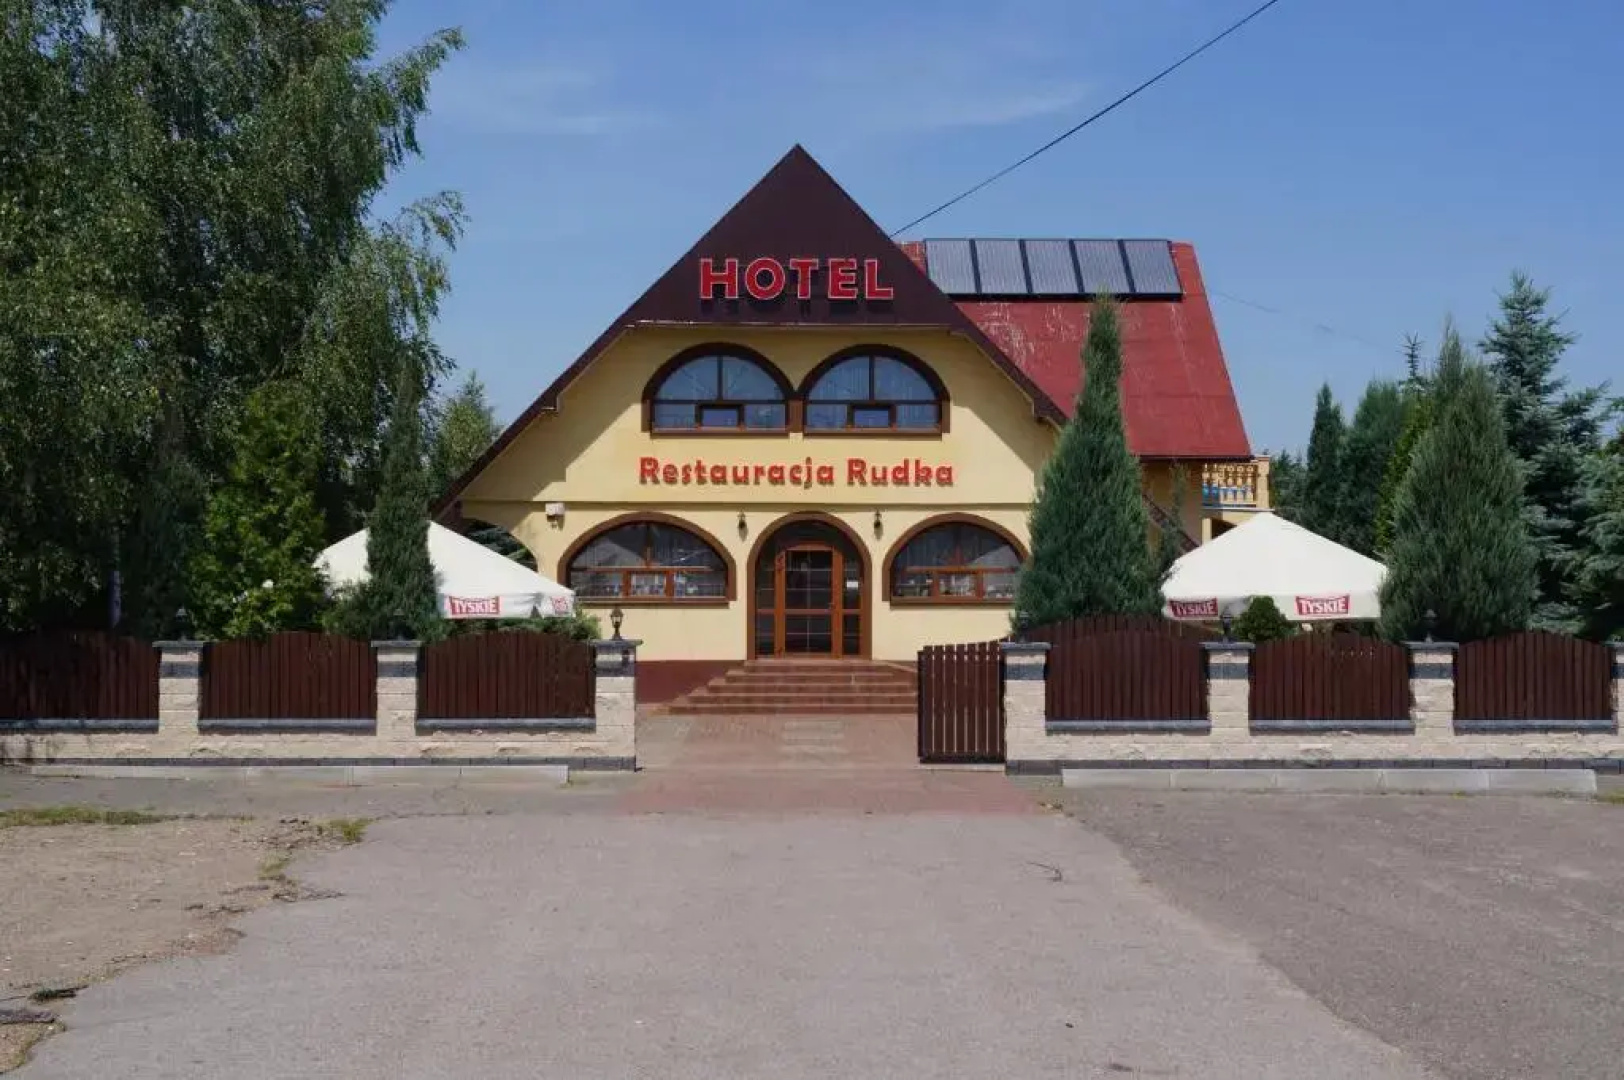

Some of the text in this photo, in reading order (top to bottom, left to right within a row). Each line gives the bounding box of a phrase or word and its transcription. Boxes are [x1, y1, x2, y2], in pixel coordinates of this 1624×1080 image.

[699, 257, 894, 299] HOTEL
[639, 456, 954, 489] Restauracja Rudka
[452, 597, 498, 613] TYSKIE
[1175, 601, 1215, 616] TYSKIE
[1300, 597, 1348, 614] TYSKIE
